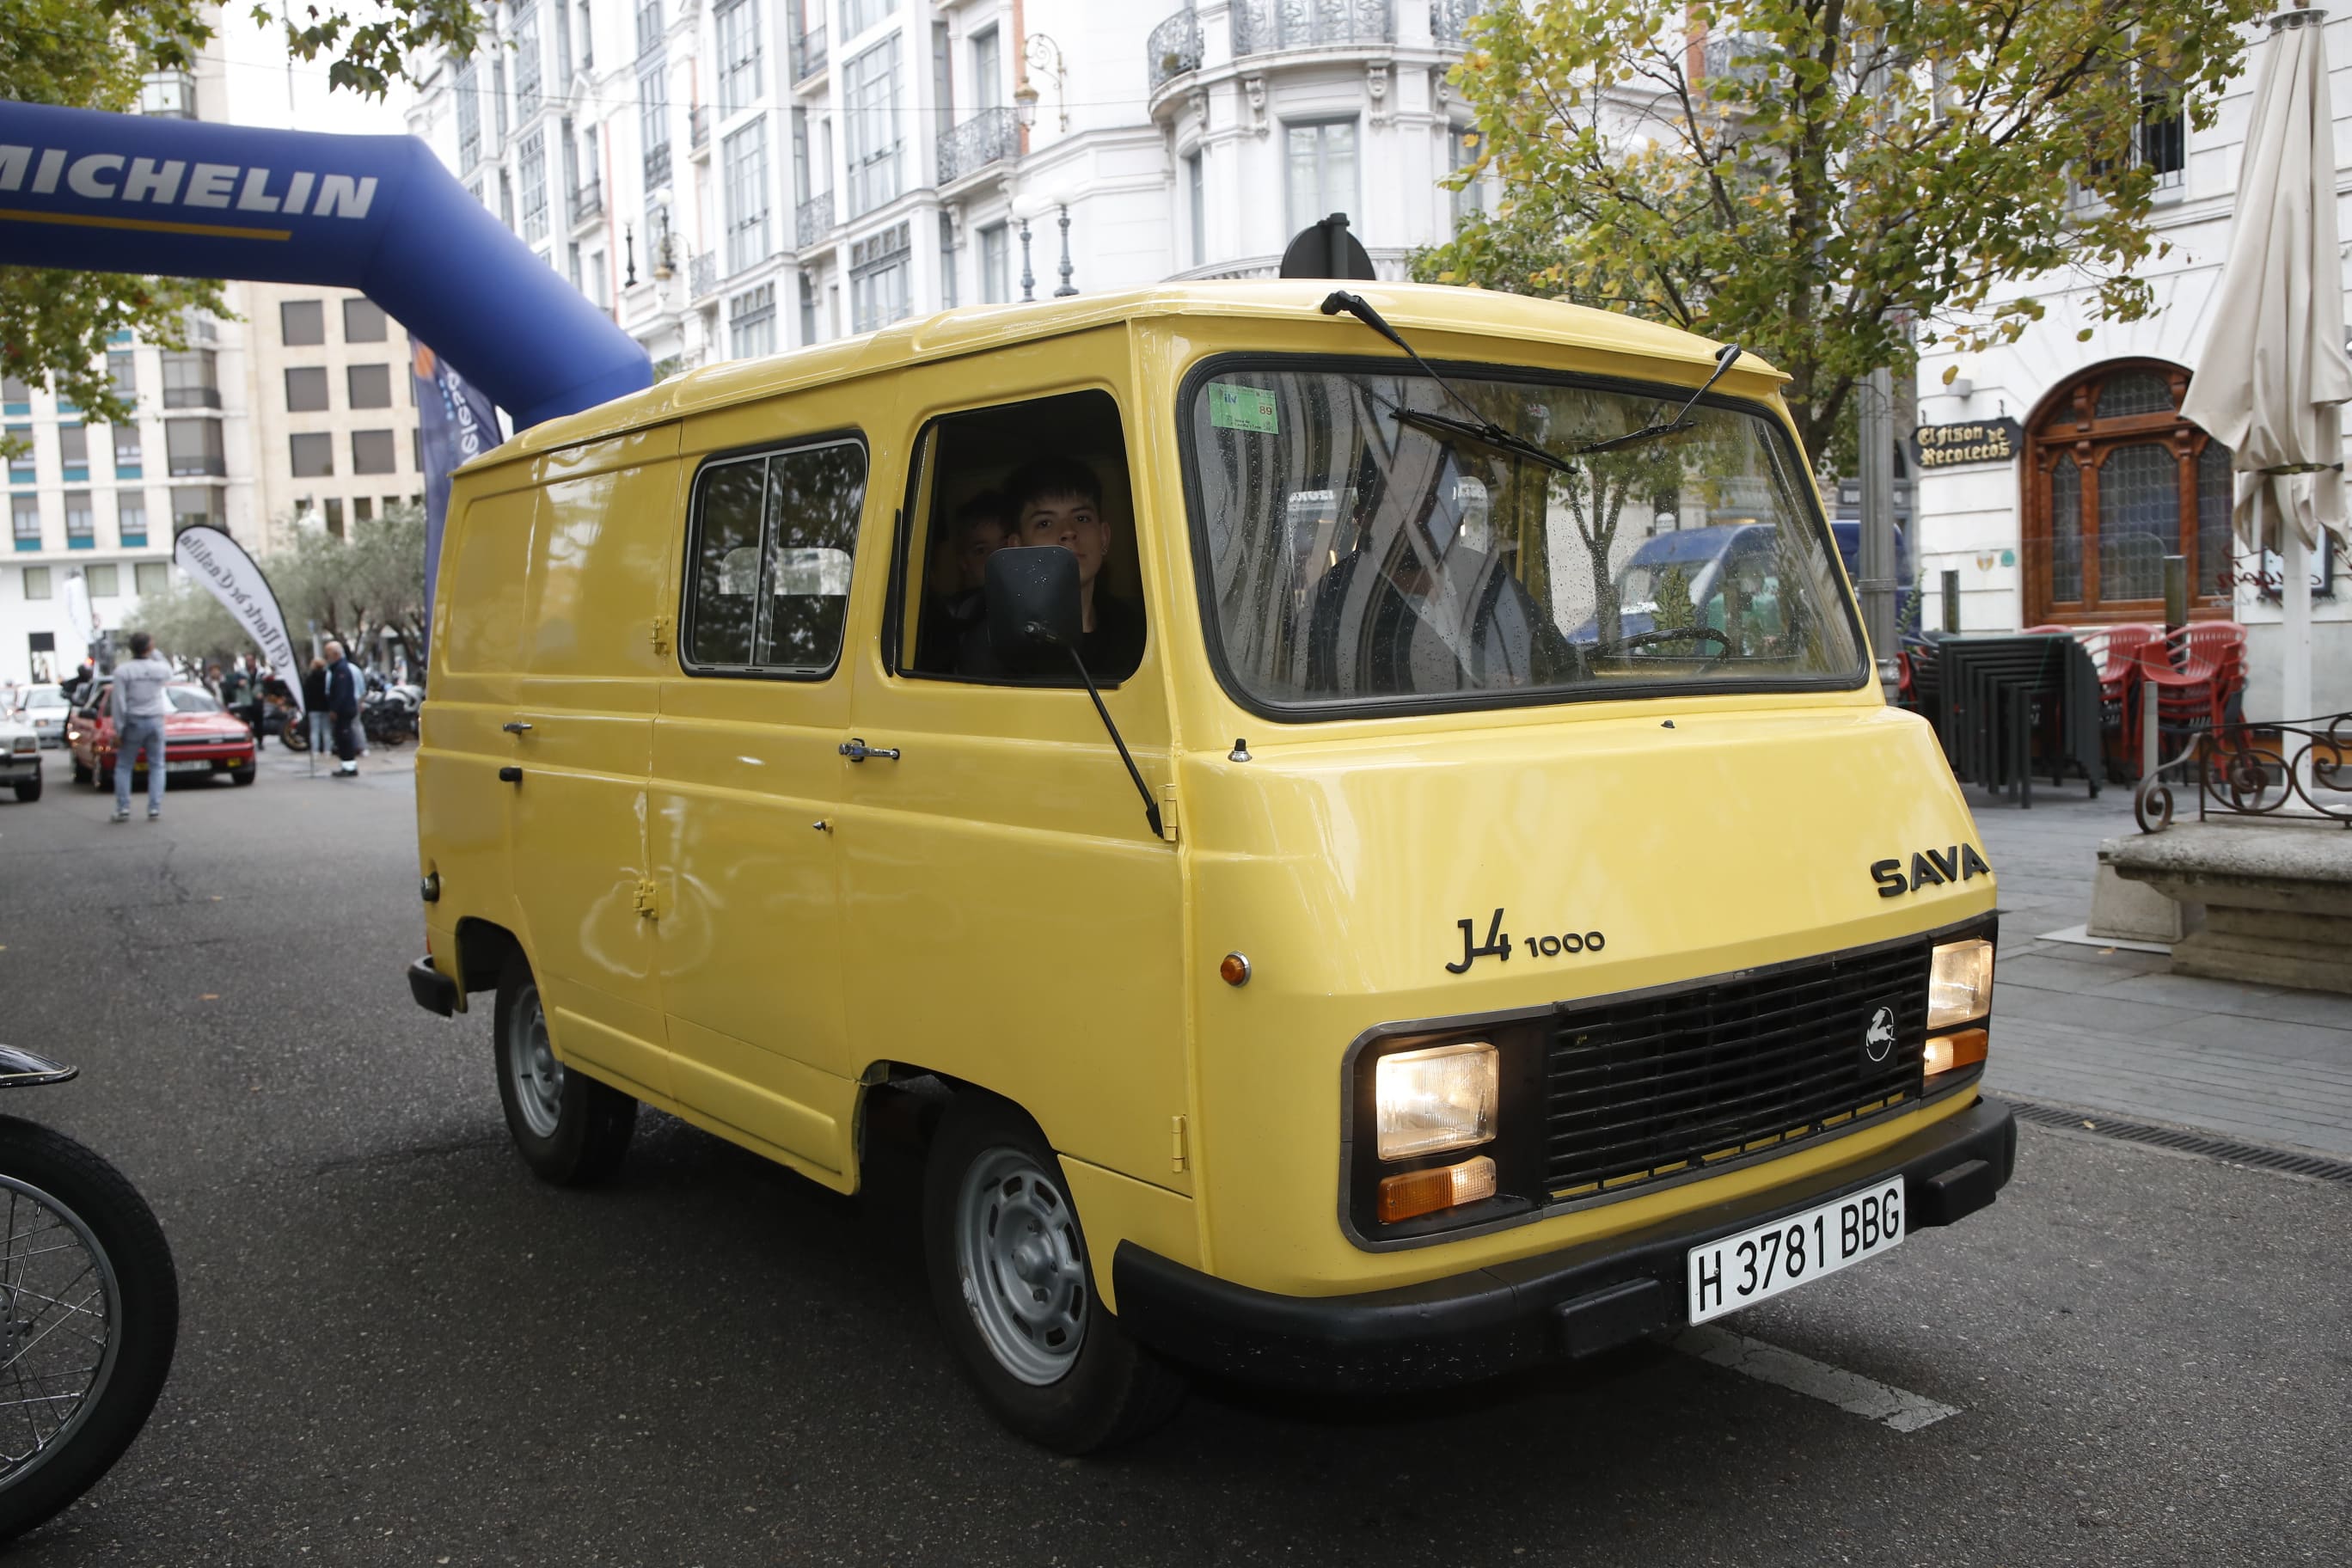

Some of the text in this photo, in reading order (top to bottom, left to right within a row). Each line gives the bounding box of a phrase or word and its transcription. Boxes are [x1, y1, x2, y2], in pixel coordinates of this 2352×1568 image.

[1259, 405, 1273, 416] 89
[1920, 440, 2012, 466] Recoletos
[1986, 426, 2006, 444] de
[1870, 842, 1991, 898] SAVA
[1445, 908, 1606, 975] J4 1000
[1699, 1188, 1900, 1313] H 3781 BBG
